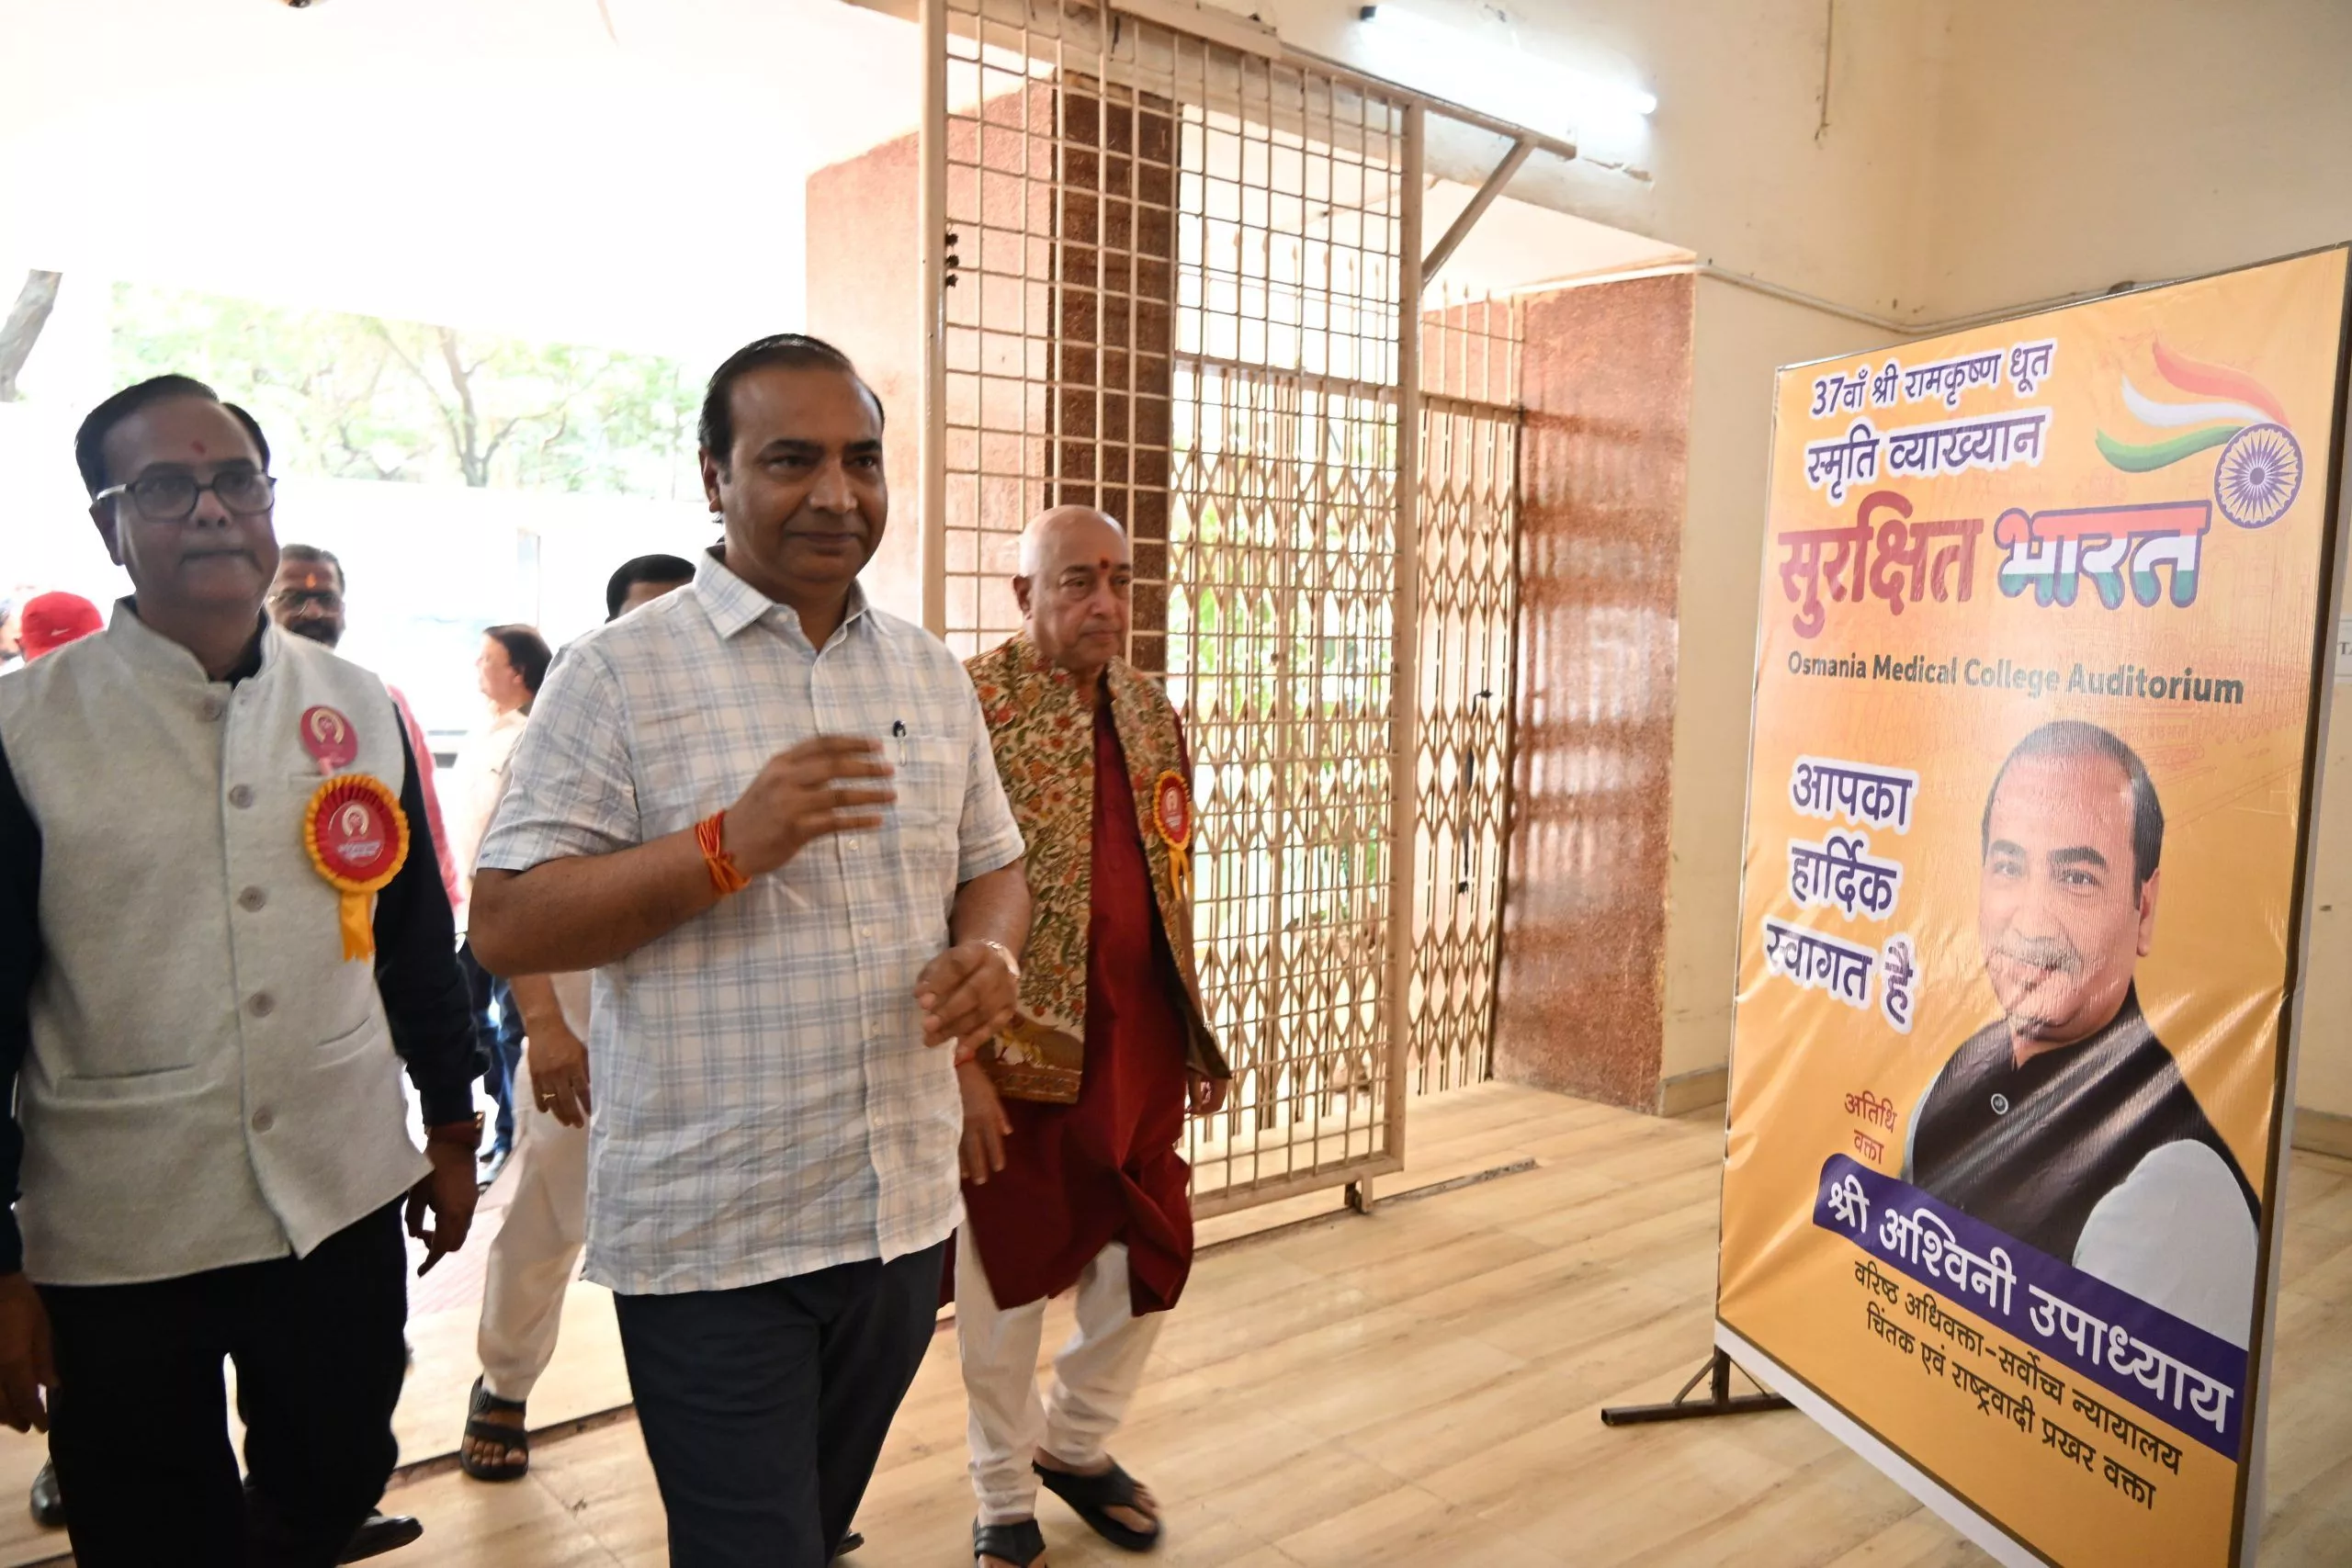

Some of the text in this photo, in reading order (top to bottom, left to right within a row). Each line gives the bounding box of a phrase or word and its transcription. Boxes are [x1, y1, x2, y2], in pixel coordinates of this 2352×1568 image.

[1871, 364, 1898, 403] श्री
[1905, 354, 2002, 405] रामकृष्ण
[2010, 344, 2053, 392] धूत
[1808, 415, 2045, 499] स्मृति व्याख्यान
[1778, 491, 2212, 638] सुरक्षित भारत
[1788, 650, 2245, 705] Osmania Medical College Auditorium
[1793, 763, 1913, 826] आपका
[1792, 836, 1897, 913] हार्दिक
[1767, 923, 1914, 1024] स्वागत है
[1844, 1090, 1897, 1134] अतिथि
[1854, 1130, 1884, 1164] वक्ता
[1828, 1174, 2234, 1433] श्री अश्विनी उपाध्याय
[1855, 1260, 1899, 1304] वरिष्ठ
[2072, 1388, 2183, 1475] न्यायालय
[1867, 1301, 2156, 1510] चिंतक एवं राष्ट्रवादी प्रखर वक्ता
